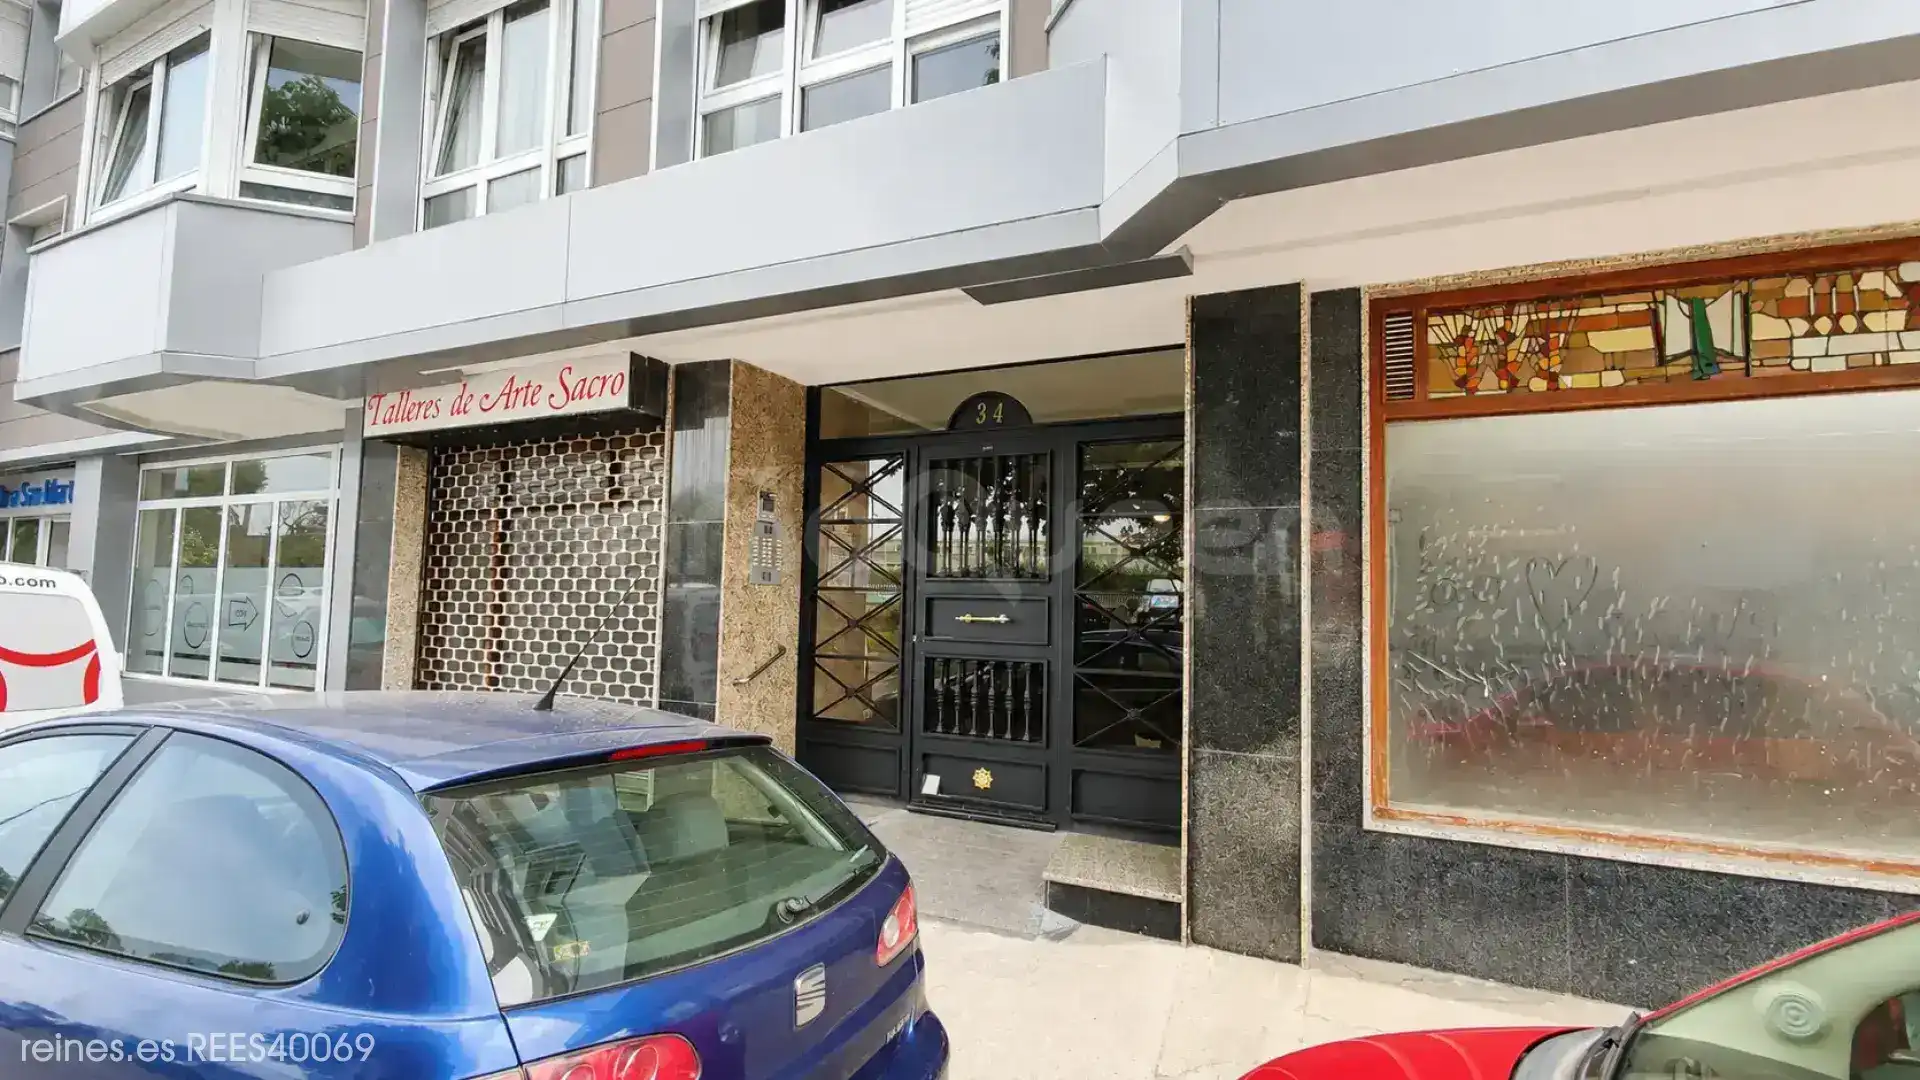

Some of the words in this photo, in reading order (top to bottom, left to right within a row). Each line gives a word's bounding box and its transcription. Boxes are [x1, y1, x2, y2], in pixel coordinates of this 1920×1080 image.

[368, 391, 441, 425] Talleres
[450, 381, 475, 416] de
[479, 375, 543, 412] Arte
[549, 364, 625, 410] Sacro
[976, 401, 1004, 424] 34
